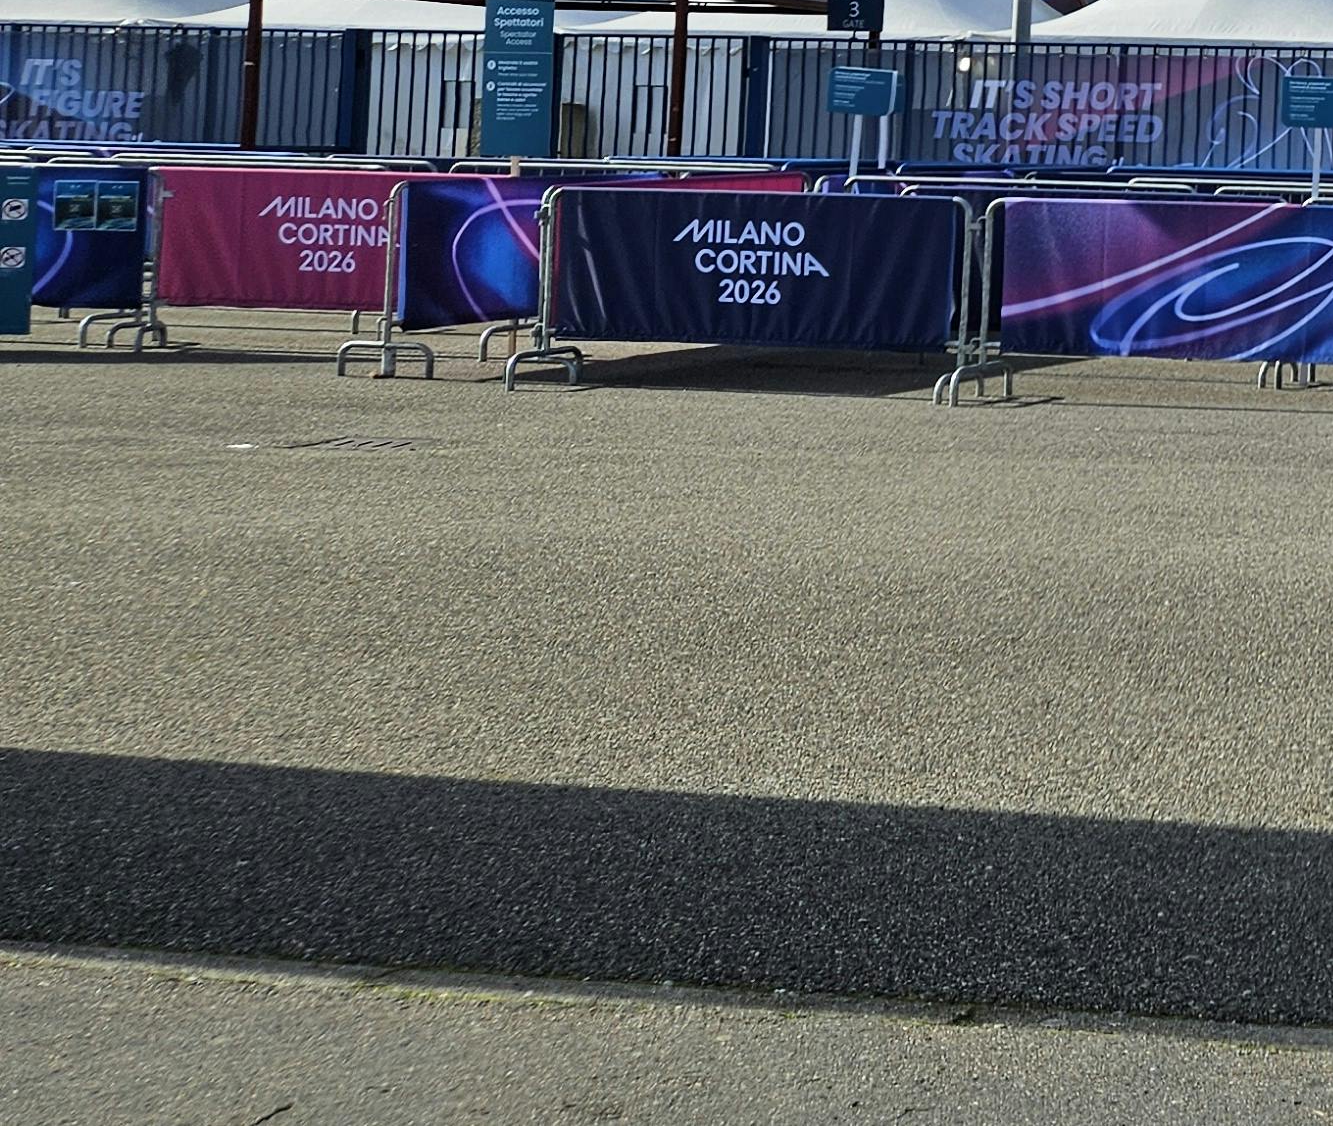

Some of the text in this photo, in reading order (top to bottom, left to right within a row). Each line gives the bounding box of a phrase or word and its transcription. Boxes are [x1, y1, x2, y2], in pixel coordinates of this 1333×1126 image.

[842, 19, 865, 28] GATE
[848, 1, 860, 18] 3
[20, 58, 82, 87] IT'S
[29, 89, 145, 118] FIGURE
[969, 79, 1163, 111] IT'S SHORT
[932, 110, 1164, 143] TRACK SPEED
[953, 142, 1108, 166] SKATING
[258, 195, 379, 221] MILANO
[672, 218, 806, 247] MILANO
[298, 250, 356, 274] 2026
[694, 248, 831, 277] CORTINA
[718, 278, 782, 305] 2026
